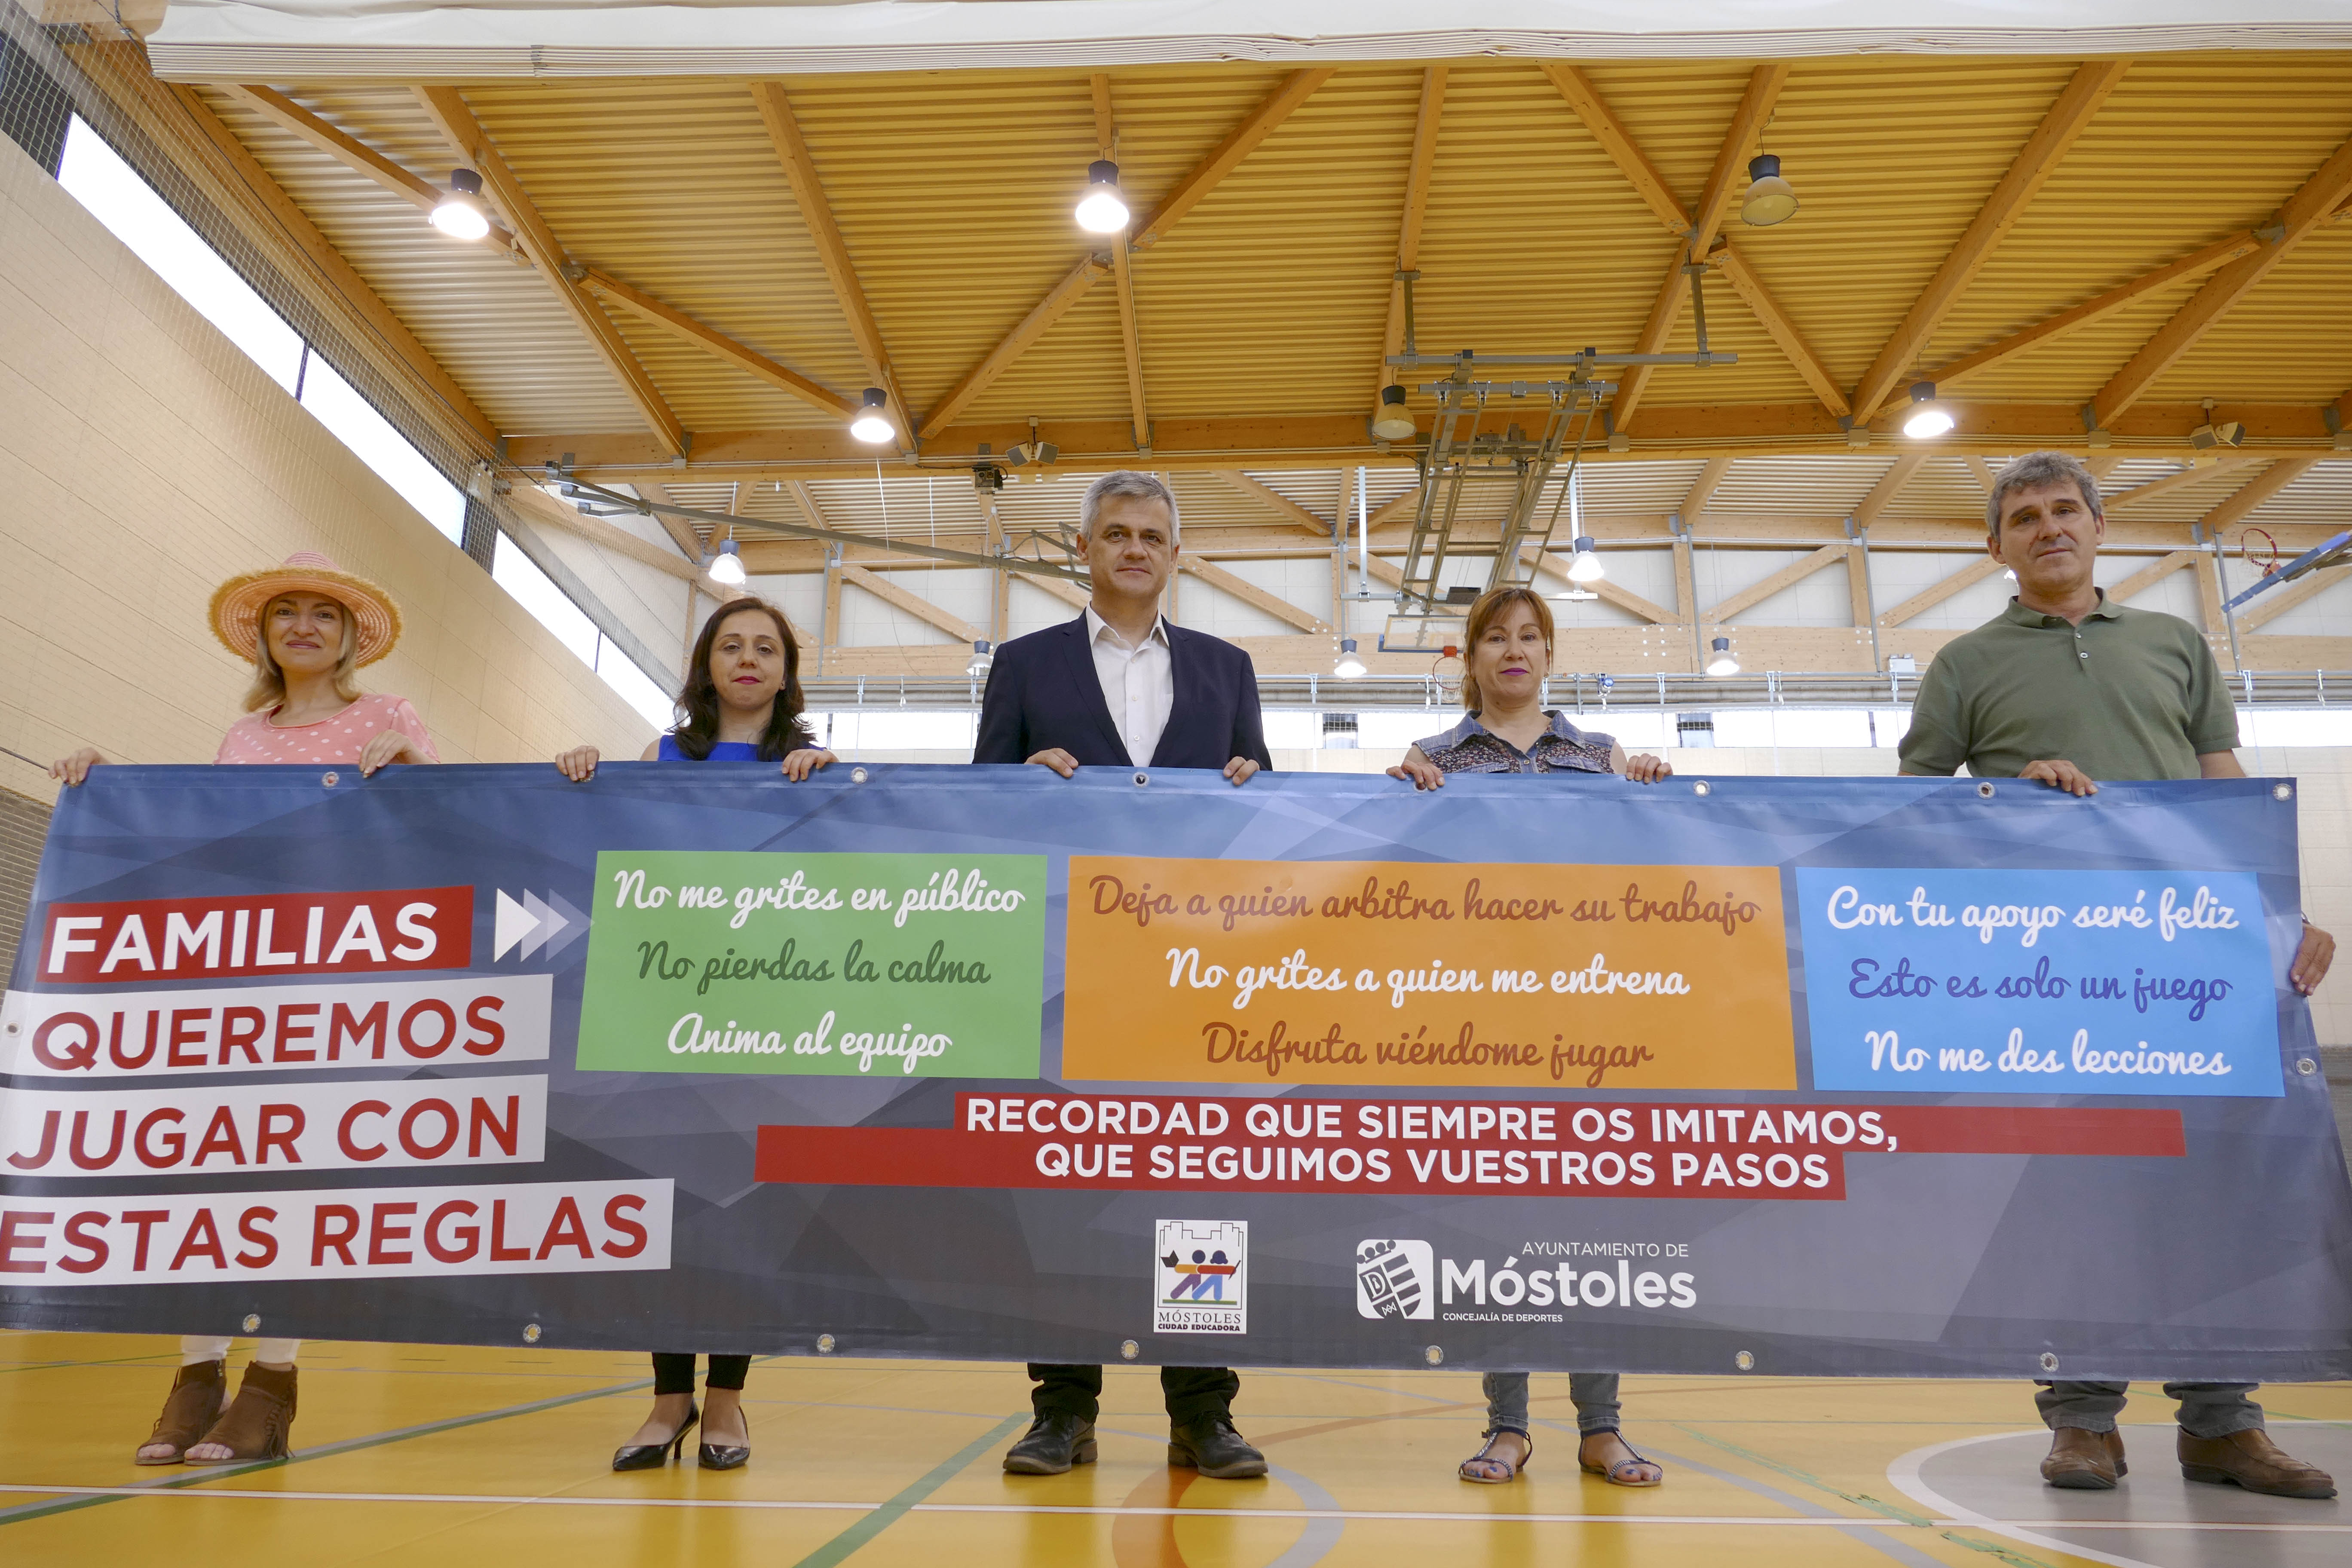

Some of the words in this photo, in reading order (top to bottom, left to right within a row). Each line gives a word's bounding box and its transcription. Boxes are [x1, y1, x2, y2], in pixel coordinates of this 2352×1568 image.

[613, 870, 671, 909] No
[678, 888, 728, 908] me
[730, 871, 843, 929] grites
[851, 888, 892, 910] en
[894, 869, 1026, 928] público
[1089, 875, 1178, 928] Deja
[1187, 894, 1212, 917] a
[1219, 885, 1312, 931] quien
[1322, 876, 1454, 922] arbitra
[1463, 878, 1564, 922] hacer
[1570, 900, 1617, 922] su
[1619, 880, 1761, 936] trabajo
[1827, 885, 1903, 930] Con
[1905, 886, 1954, 927] tu
[1961, 904, 2066, 947] apoyo
[2072, 891, 2153, 929] seré
[2159, 887, 2239, 941] feliz
[47, 902, 438, 974] FAMILIAS
[637, 940, 695, 981] No
[697, 937, 835, 996] pierdas
[844, 939, 880, 983] la
[888, 940, 991, 984] calma
[1166, 947, 1229, 990] No
[1233, 948, 1348, 1009] grites
[1355, 968, 1380, 992] a
[1386, 959, 1483, 1008] quien
[1491, 971, 1544, 994] me
[1550, 952, 1690, 996] entrena
[1848, 957, 1937, 999] Esto
[1946, 976, 1988, 998] es
[1994, 956, 2071, 999] solo
[2080, 978, 2126, 1000] un
[2134, 968, 2233, 1021] juego
[32, 995, 505, 1072] QUEREMOS
[667, 1013, 787, 1055] Anima
[793, 1011, 835, 1055] al
[839, 1023, 952, 1074] equipo
[1202, 1021, 1366, 1077] Disfruta
[1375, 1020, 1544, 1068] viéndome
[1550, 1033, 1654, 1088] jugar
[1864, 1030, 1930, 1072] No
[1939, 1048, 1991, 1072] me
[1998, 1027, 2065, 1074] des
[2072, 1028, 2232, 1075] lecciones
[6, 1104, 306, 1170] JUGAR
[337, 1095, 520, 1162] CON
[967, 1099, 1232, 1135] RECORDAD
[1244, 1103, 1341, 1140] QUE
[1357, 1106, 1556, 1142] SIEMPRE
[1571, 1109, 1635, 1142] OS
[1651, 1109, 1899, 1152] IMITAMOS,
[1035, 1142, 1134, 1181] QUE
[1149, 1145, 1392, 1183] SEGUIMOS
[1405, 1149, 1655, 1187] VUESTROS
[1672, 1153, 1829, 1189] PASOS
[0, 1206, 279, 1274] ESTAS
[310, 1192, 648, 1268] REGLAS
[1522, 1242, 1660, 1257] AYUNTAMIENTO
[1666, 1244, 1689, 1257] DE
[1442, 1256, 1697, 1308] Móstoles
[1159, 1309, 1240, 1323] MÓSTOLES
[1443, 1313, 1500, 1321] CONCEJALÍA
[1516, 1314, 1563, 1322] DEPORTES
